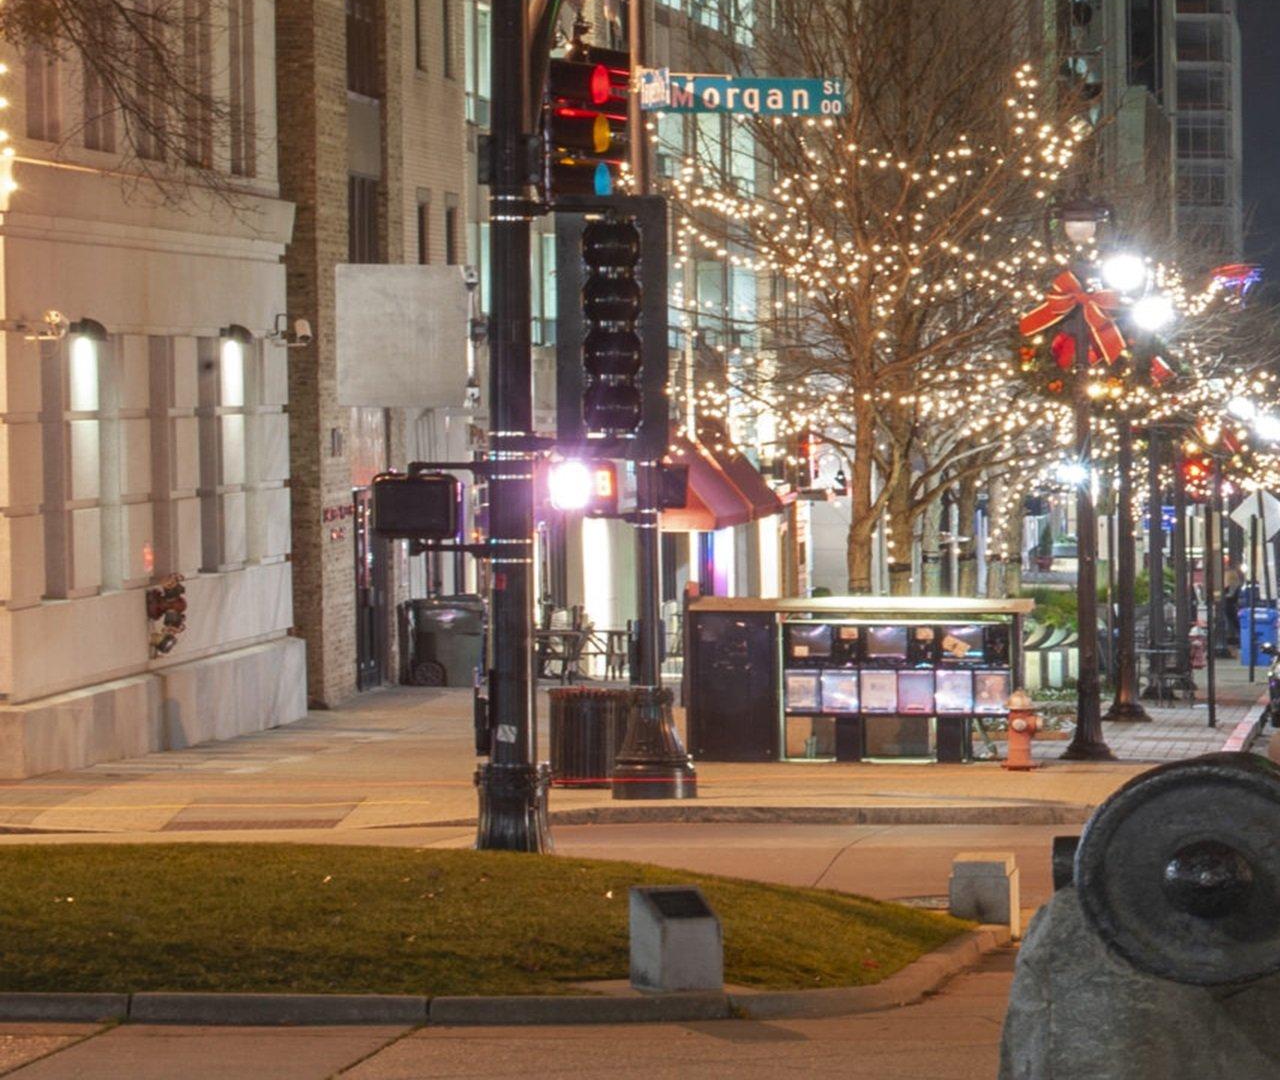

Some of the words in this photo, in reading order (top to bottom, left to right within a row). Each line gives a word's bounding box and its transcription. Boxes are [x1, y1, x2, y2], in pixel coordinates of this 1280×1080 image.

[671, 81, 809, 113] Morgan
[823, 80, 841, 95] St
[820, 99, 842, 114] 00
